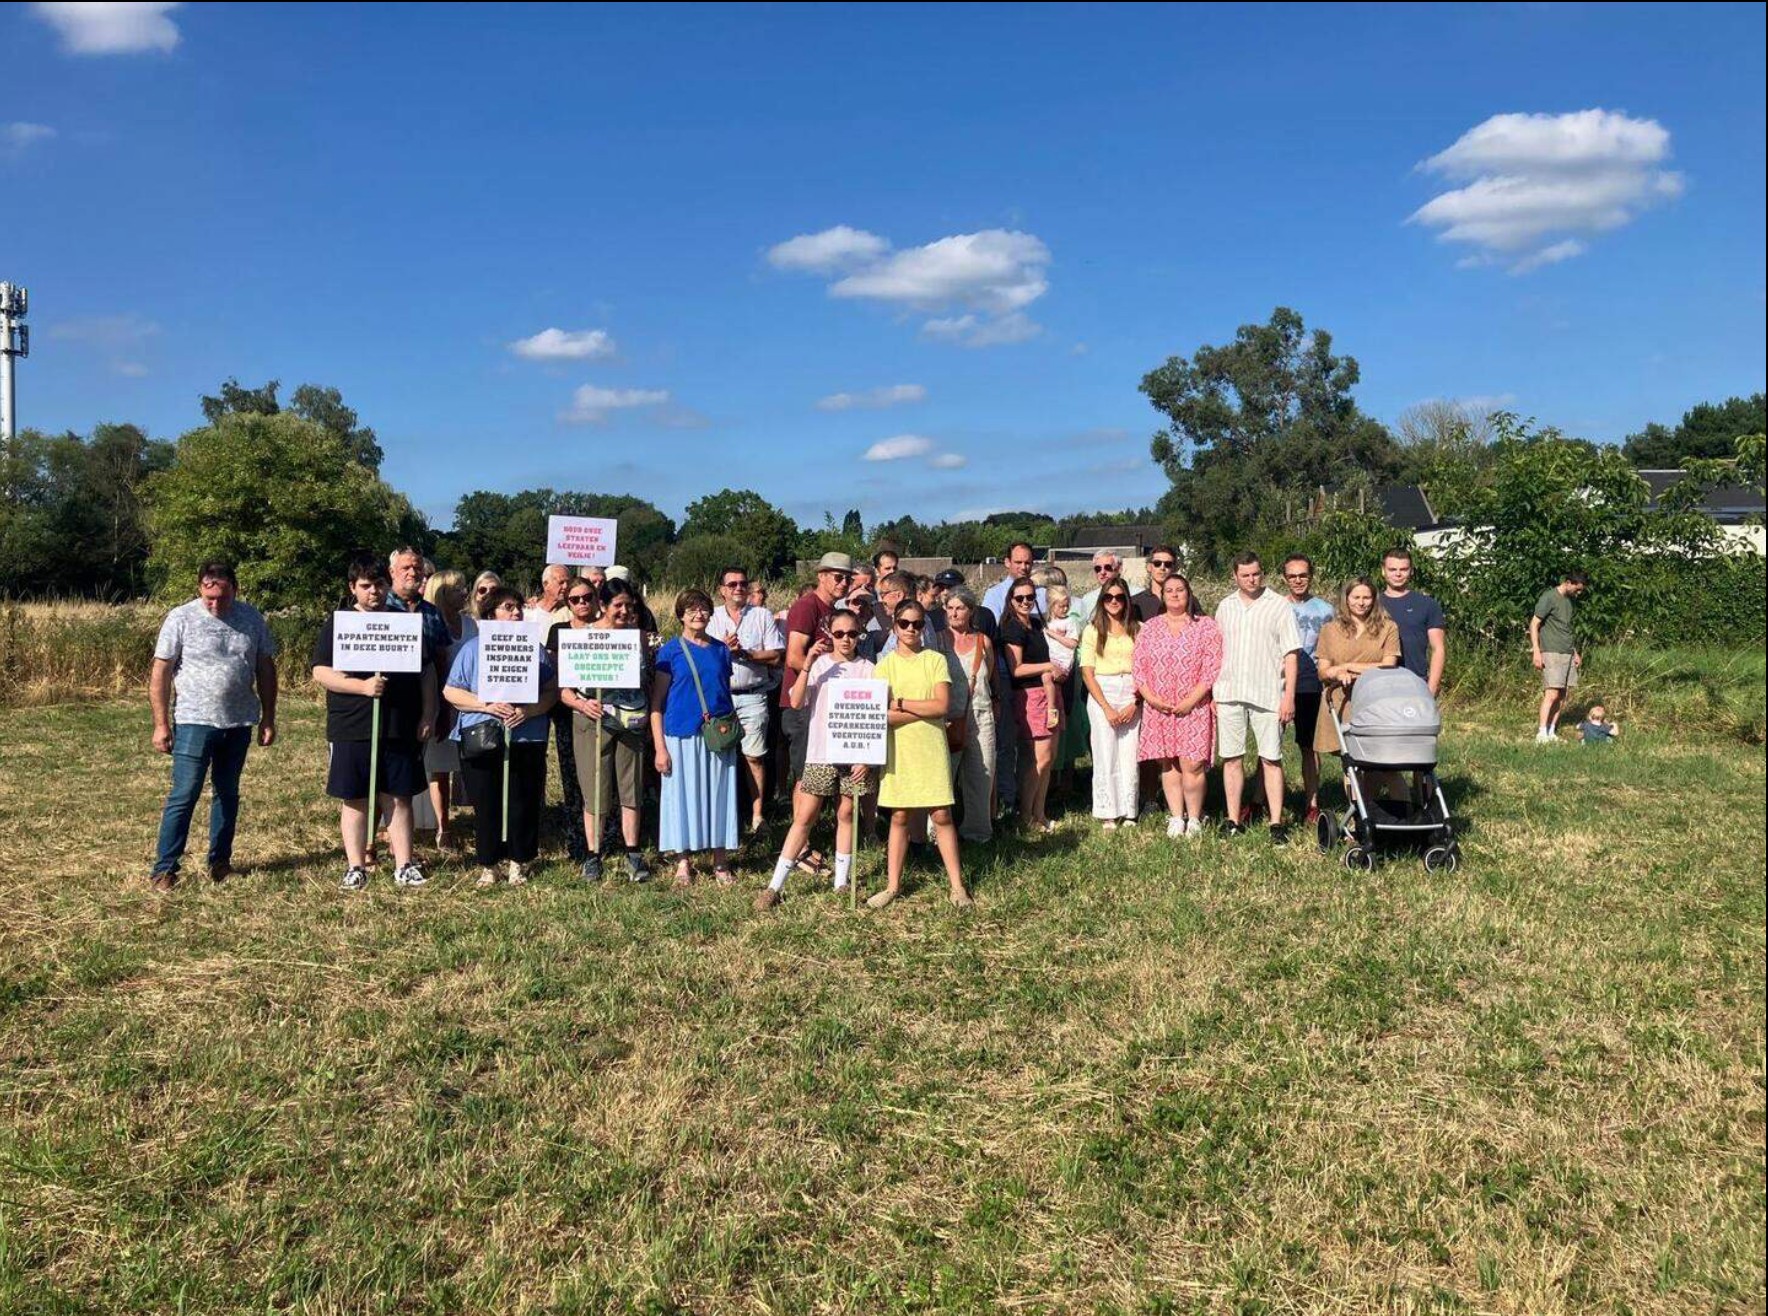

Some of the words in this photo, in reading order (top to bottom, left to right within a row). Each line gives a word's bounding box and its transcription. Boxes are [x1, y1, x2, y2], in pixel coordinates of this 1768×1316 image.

[337, 632, 418, 642] APPARTEMENTEN
[485, 644, 534, 652] BEWONERS
[487, 654, 532, 662] INSPRAAK
[487, 675, 522, 683] STREEK
[844, 690, 872, 700] GEEN
[834, 702, 881, 710] OVERVOLLE
